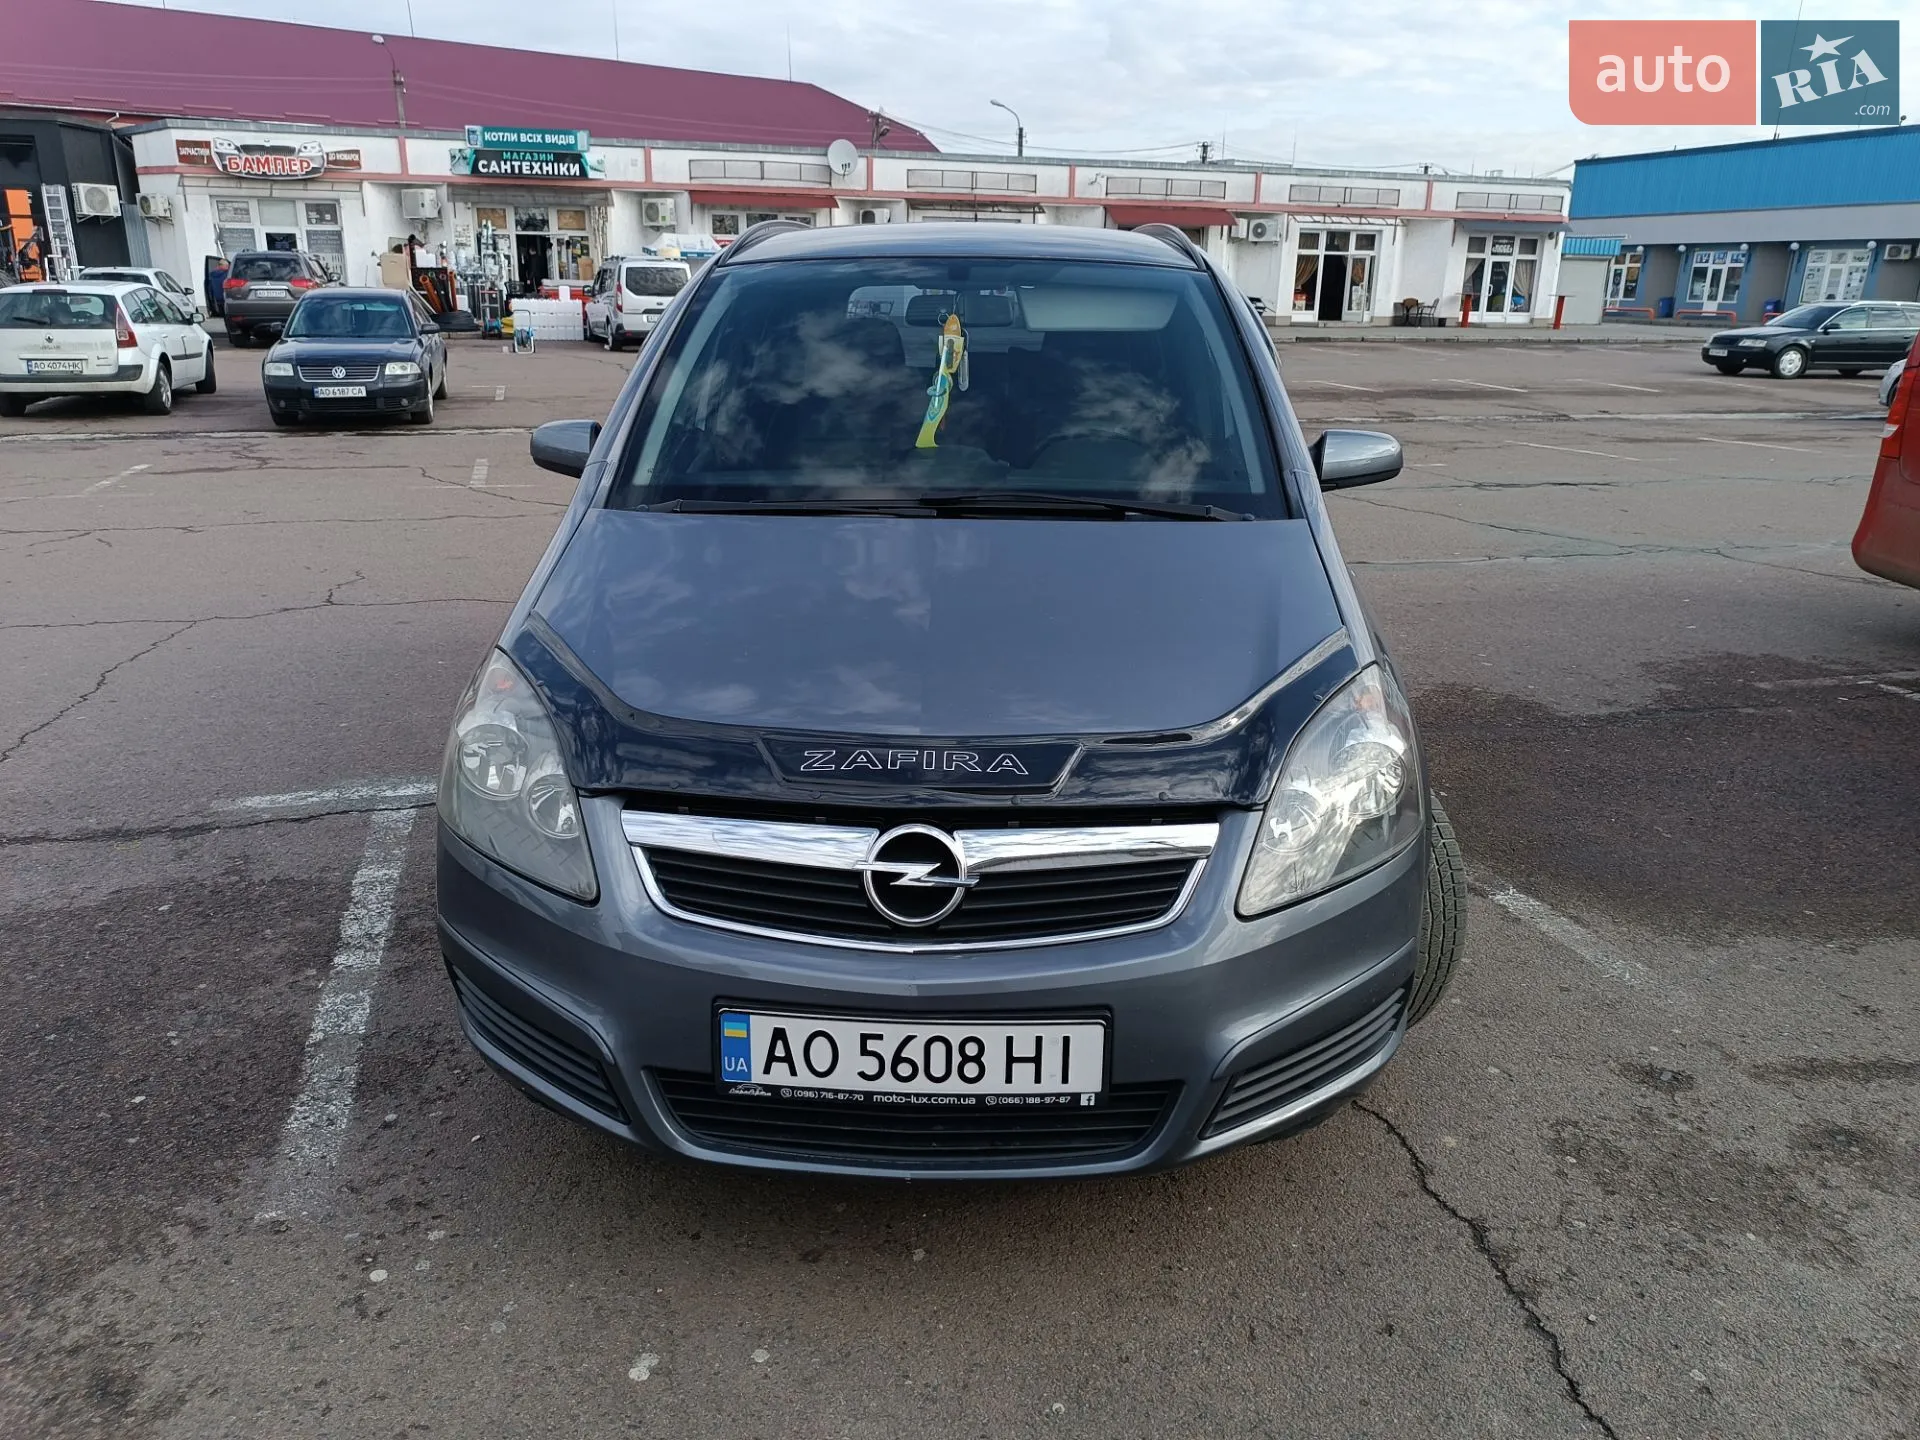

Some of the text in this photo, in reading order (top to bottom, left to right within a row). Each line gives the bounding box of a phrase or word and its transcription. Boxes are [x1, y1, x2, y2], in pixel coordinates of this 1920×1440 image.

[484, 131, 576, 145] КОТЛИ ВСІХ ВИДІВ
[503, 151, 554, 161] МАГАЗИН
[227, 155, 313, 176] БАМПЕР
[478, 159, 580, 176] САНТЕХНІКИ
[47, 362, 68, 370] 4074
[800, 749, 1029, 775] ZAFIRA
[723, 1055, 748, 1073] UA
[762, 1026, 1071, 1085] AO 5608 HI
[872, 1093, 977, 1105] moto-lux.com.ua
